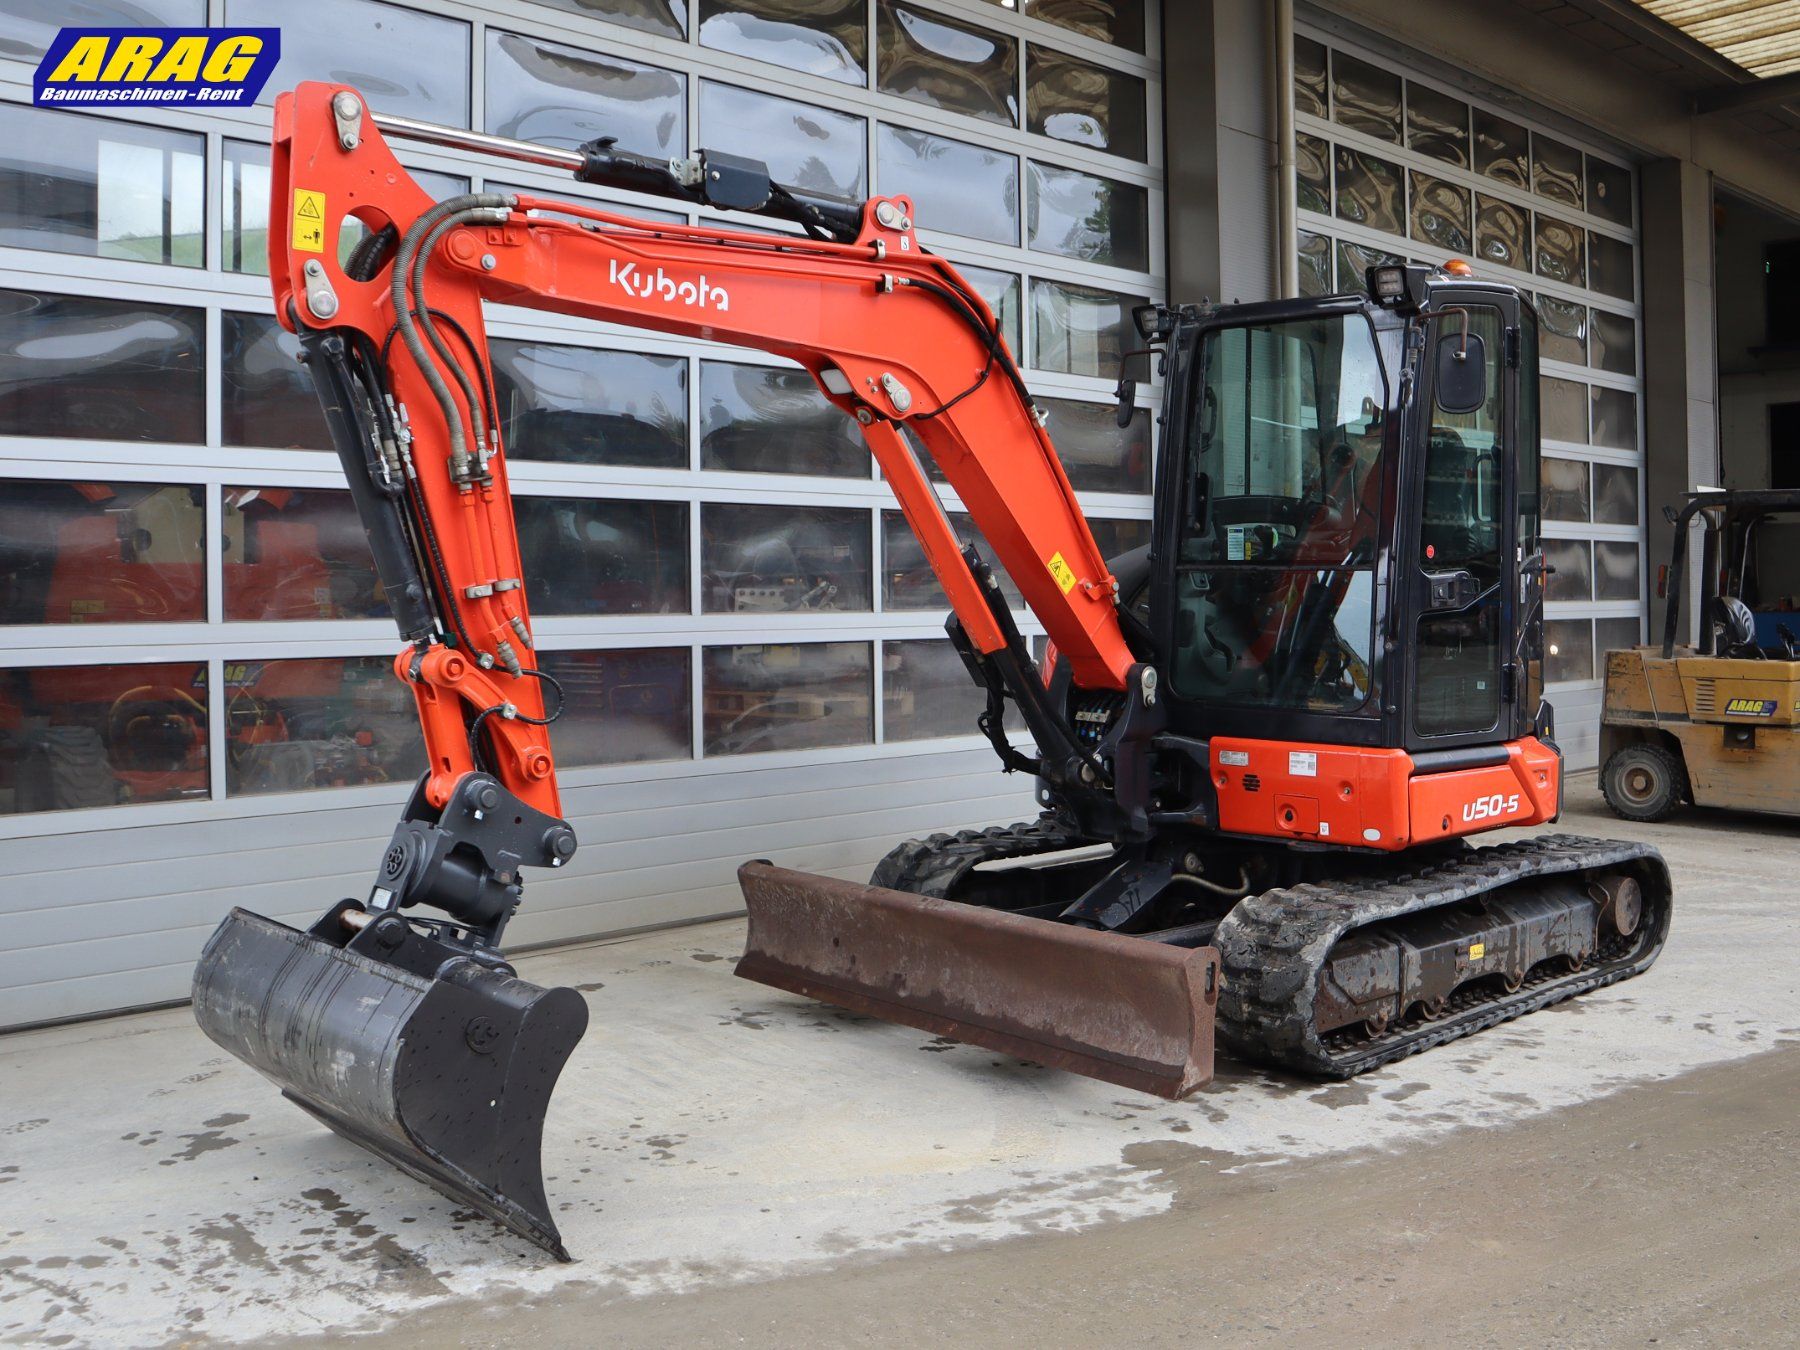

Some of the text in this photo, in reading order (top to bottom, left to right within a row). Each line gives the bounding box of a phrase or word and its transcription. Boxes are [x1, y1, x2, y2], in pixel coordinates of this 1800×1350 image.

[609, 258, 729, 312] Kubota
[1728, 699, 1764, 712] ARAG
[1462, 793, 1520, 822] U50-5
